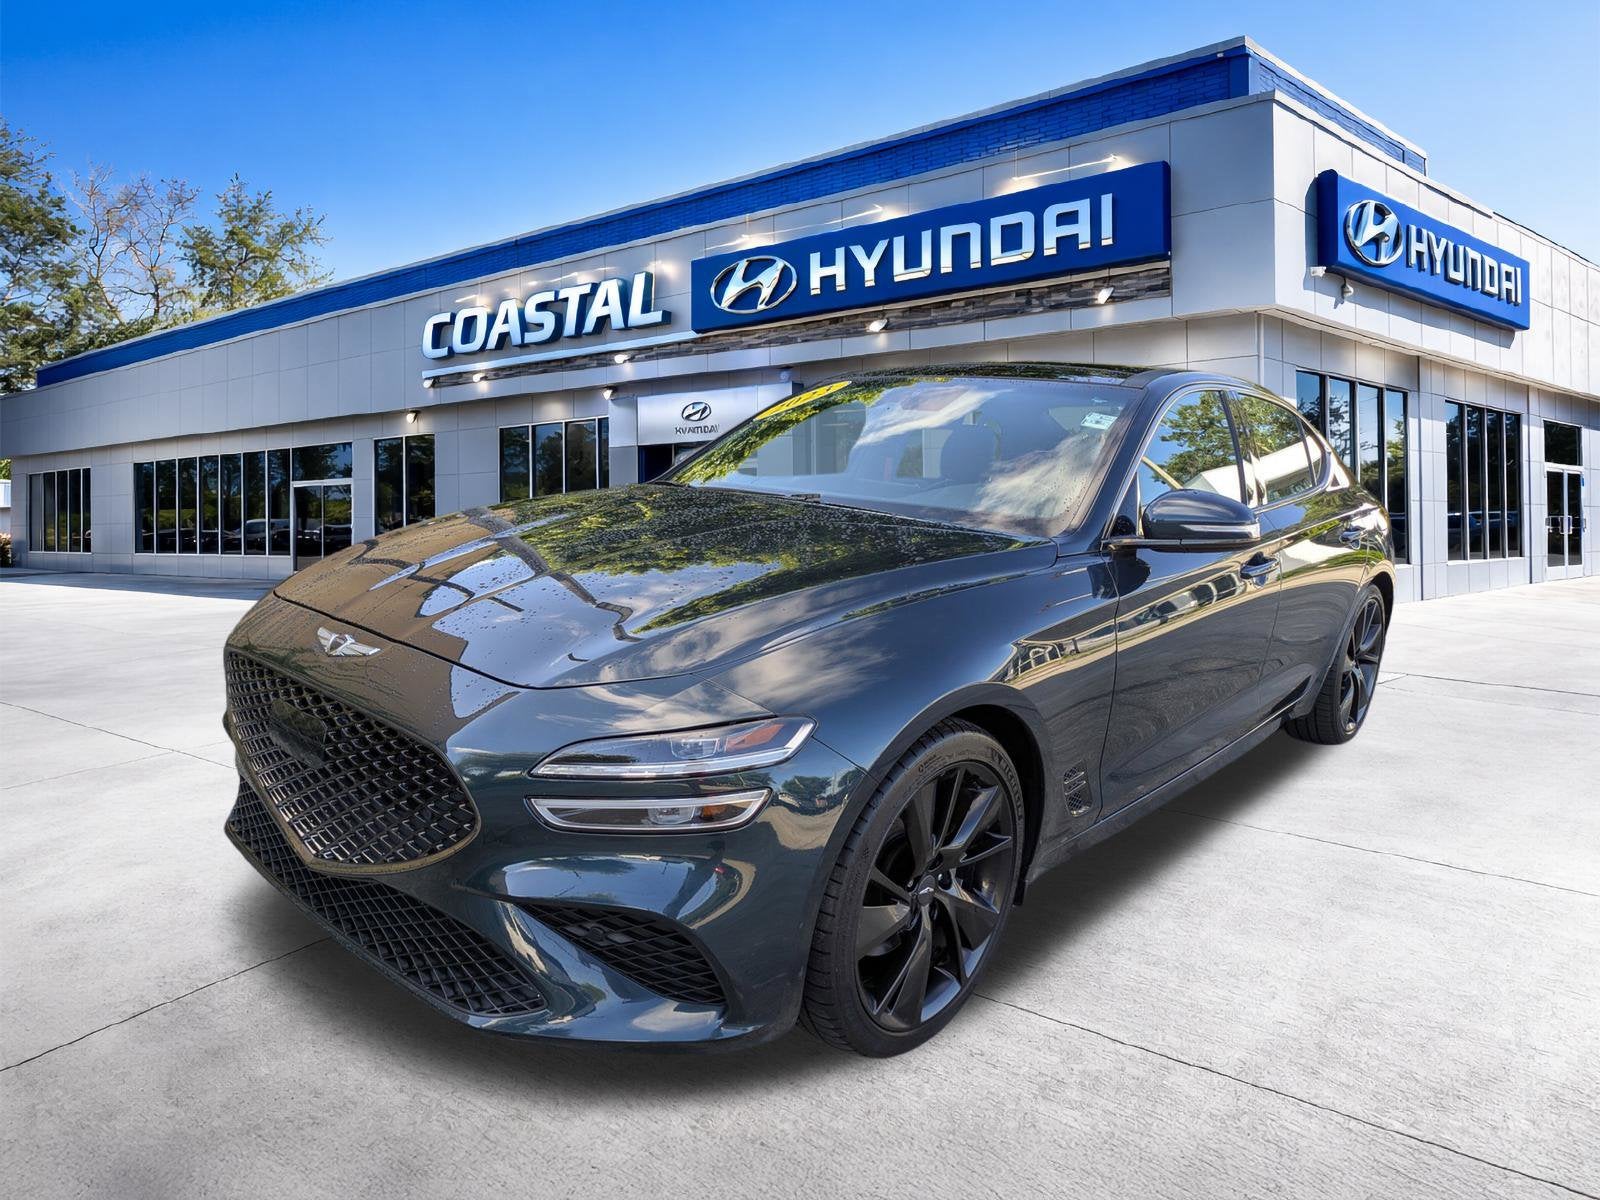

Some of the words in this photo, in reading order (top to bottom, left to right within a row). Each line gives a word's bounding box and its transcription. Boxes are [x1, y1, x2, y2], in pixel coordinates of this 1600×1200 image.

[809, 193, 1114, 296] HYUNDAI
[1406, 224, 1523, 306] HYUNDAI
[422, 271, 667, 360] COASTAL
